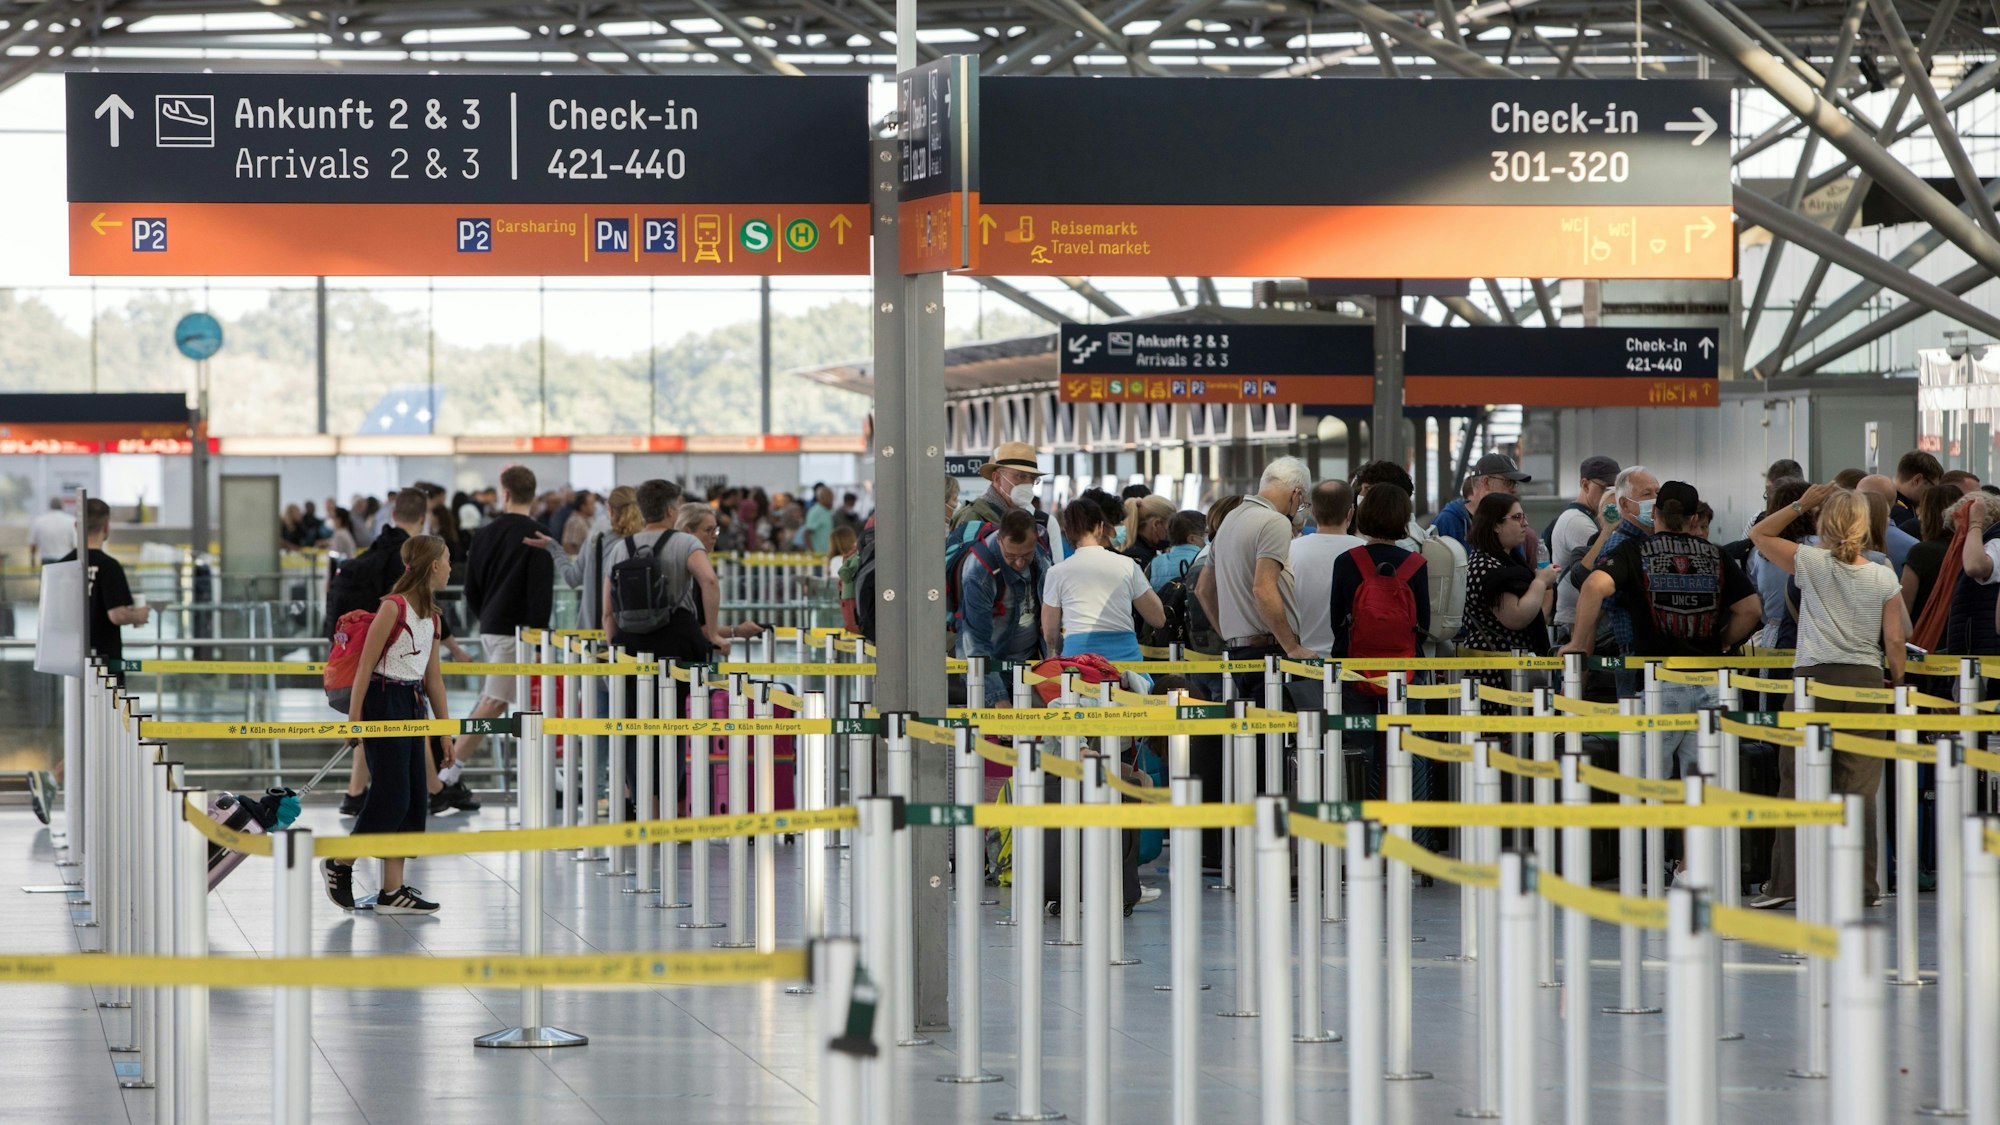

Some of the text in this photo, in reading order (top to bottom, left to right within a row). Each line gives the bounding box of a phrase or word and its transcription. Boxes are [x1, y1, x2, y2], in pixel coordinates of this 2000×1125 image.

[234, 98, 482, 130] Ankunft 2 & 3
[548, 98, 698, 131] Check-in
[1490, 101, 1639, 134] Check-in
[235, 147, 481, 179] Arrivals 2 & 3
[547, 148, 687, 181] 421-440
[1489, 150, 1630, 183] 301-320
[1051, 220, 1138, 236] Reisemarkt
[1560, 217, 1583, 233] WC
[1608, 222, 1630, 237] WC
[134, 219, 166, 250] P2
[458, 219, 577, 251] P2 Carsharing
[645, 220, 677, 251] P3
[744, 221, 770, 251] S
[1051, 239, 1151, 255] Travel market
[1136, 334, 1230, 349] Ankunft 2 & 3
[1625, 337, 1688, 352] Check-in
[1136, 352, 1230, 367] Arrivals 2 & 3
[1625, 357, 1683, 372] 421-440
[1653, 577, 1716, 589] SPEED RACE
[980, 712, 995, 720] Köln
[1015, 712, 1041, 721] Airport
[1087, 711, 1103, 719] Köln
[1122, 711, 1148, 719] Airport
[250, 726, 315, 736] Köln Bonn Airport
[365, 724, 430, 733] Köln Bonn Airport
[625, 722, 689, 732] Köln Bonn Airport
[738, 722, 801, 732] Köln Bonn Airport
